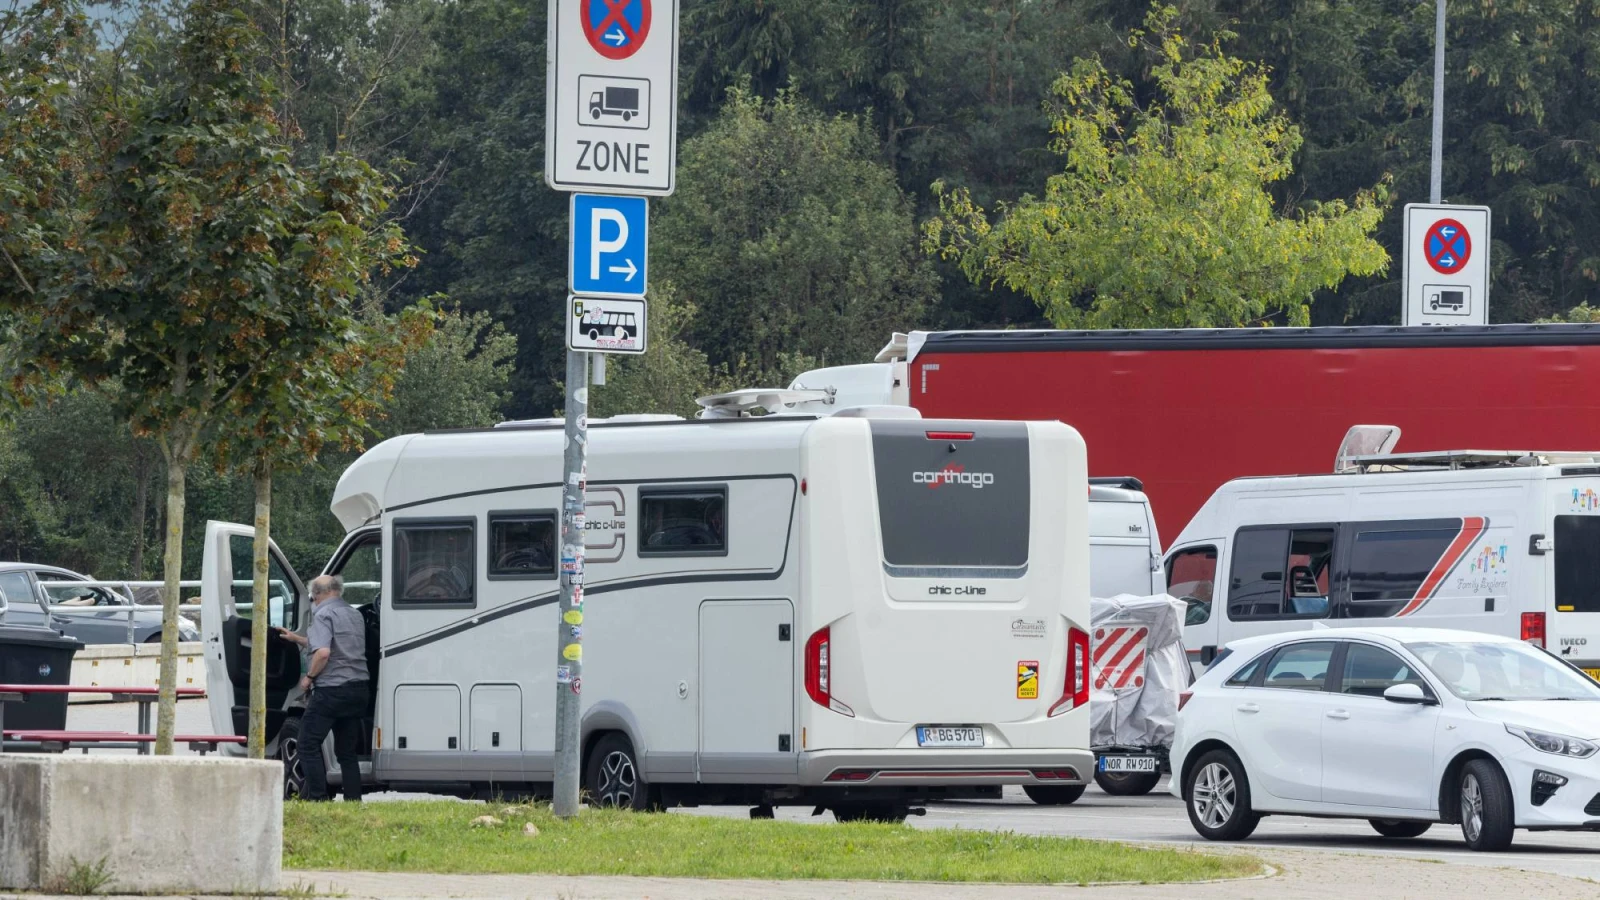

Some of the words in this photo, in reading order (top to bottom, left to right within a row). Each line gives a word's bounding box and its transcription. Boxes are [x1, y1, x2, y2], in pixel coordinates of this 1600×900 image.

[576, 140, 650, 174] ZONE
[590, 207, 629, 280] P
[912, 469, 994, 488] carthago
[584, 520, 601, 530] chic
[603, 519, 625, 530] c-line
[928, 585, 952, 595] chic
[954, 585, 987, 595] c-line
[1560, 638, 1587, 646] IVECO
[924, 728, 933, 741] R
[1105, 758, 1121, 769] NOR
